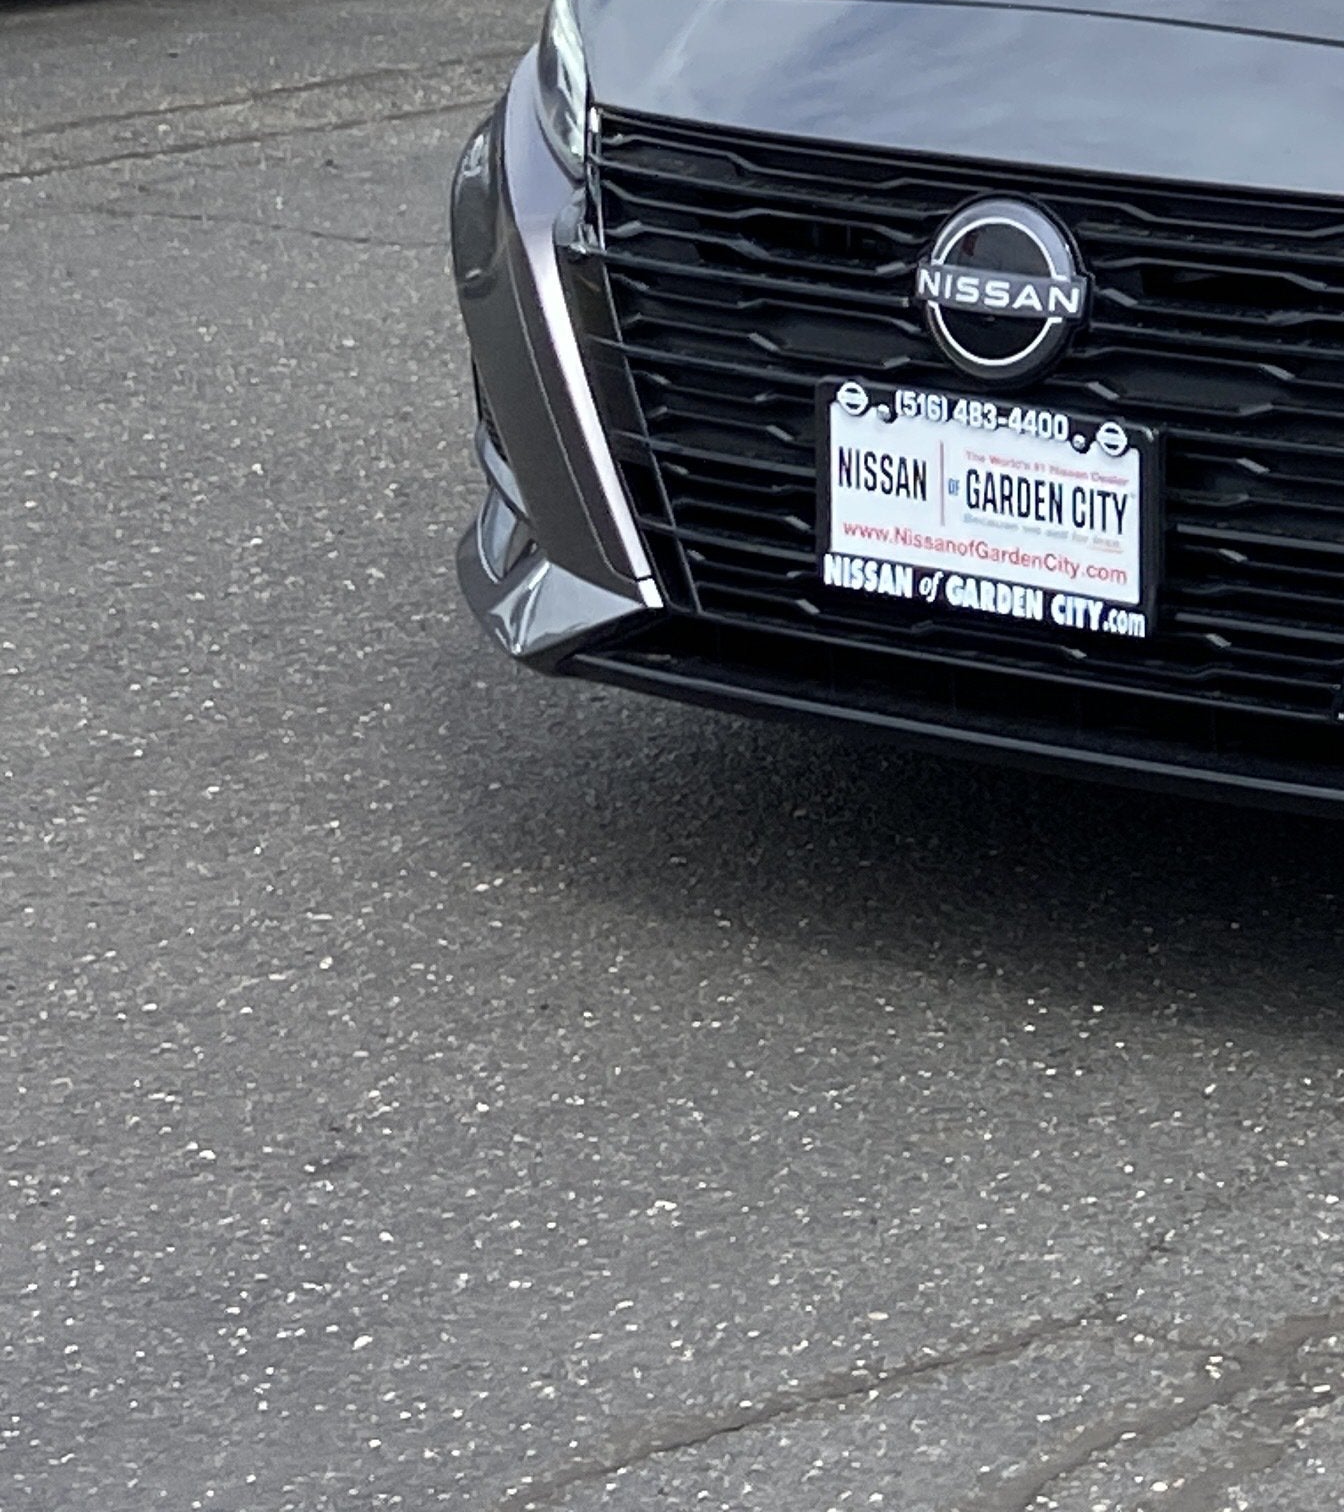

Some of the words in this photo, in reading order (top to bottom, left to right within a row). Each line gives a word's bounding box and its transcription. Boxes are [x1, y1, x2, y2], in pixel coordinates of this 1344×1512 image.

[917, 268, 1081, 314] NISSAN
[895, 389, 948, 421] (516)
[953, 398, 1069, 442] 483-4400
[838, 445, 927, 501] NISSAN
[966, 468, 1063, 526] GARDEN
[1072, 485, 1128, 536] CITY
[843, 521, 1128, 585] www.NissanofGardenCity.com
[823, 553, 913, 599] NISSAN
[918, 570, 945, 603] of
[945, 574, 1044, 621] GARDEN
[1051, 593, 1146, 639] CITY.com
